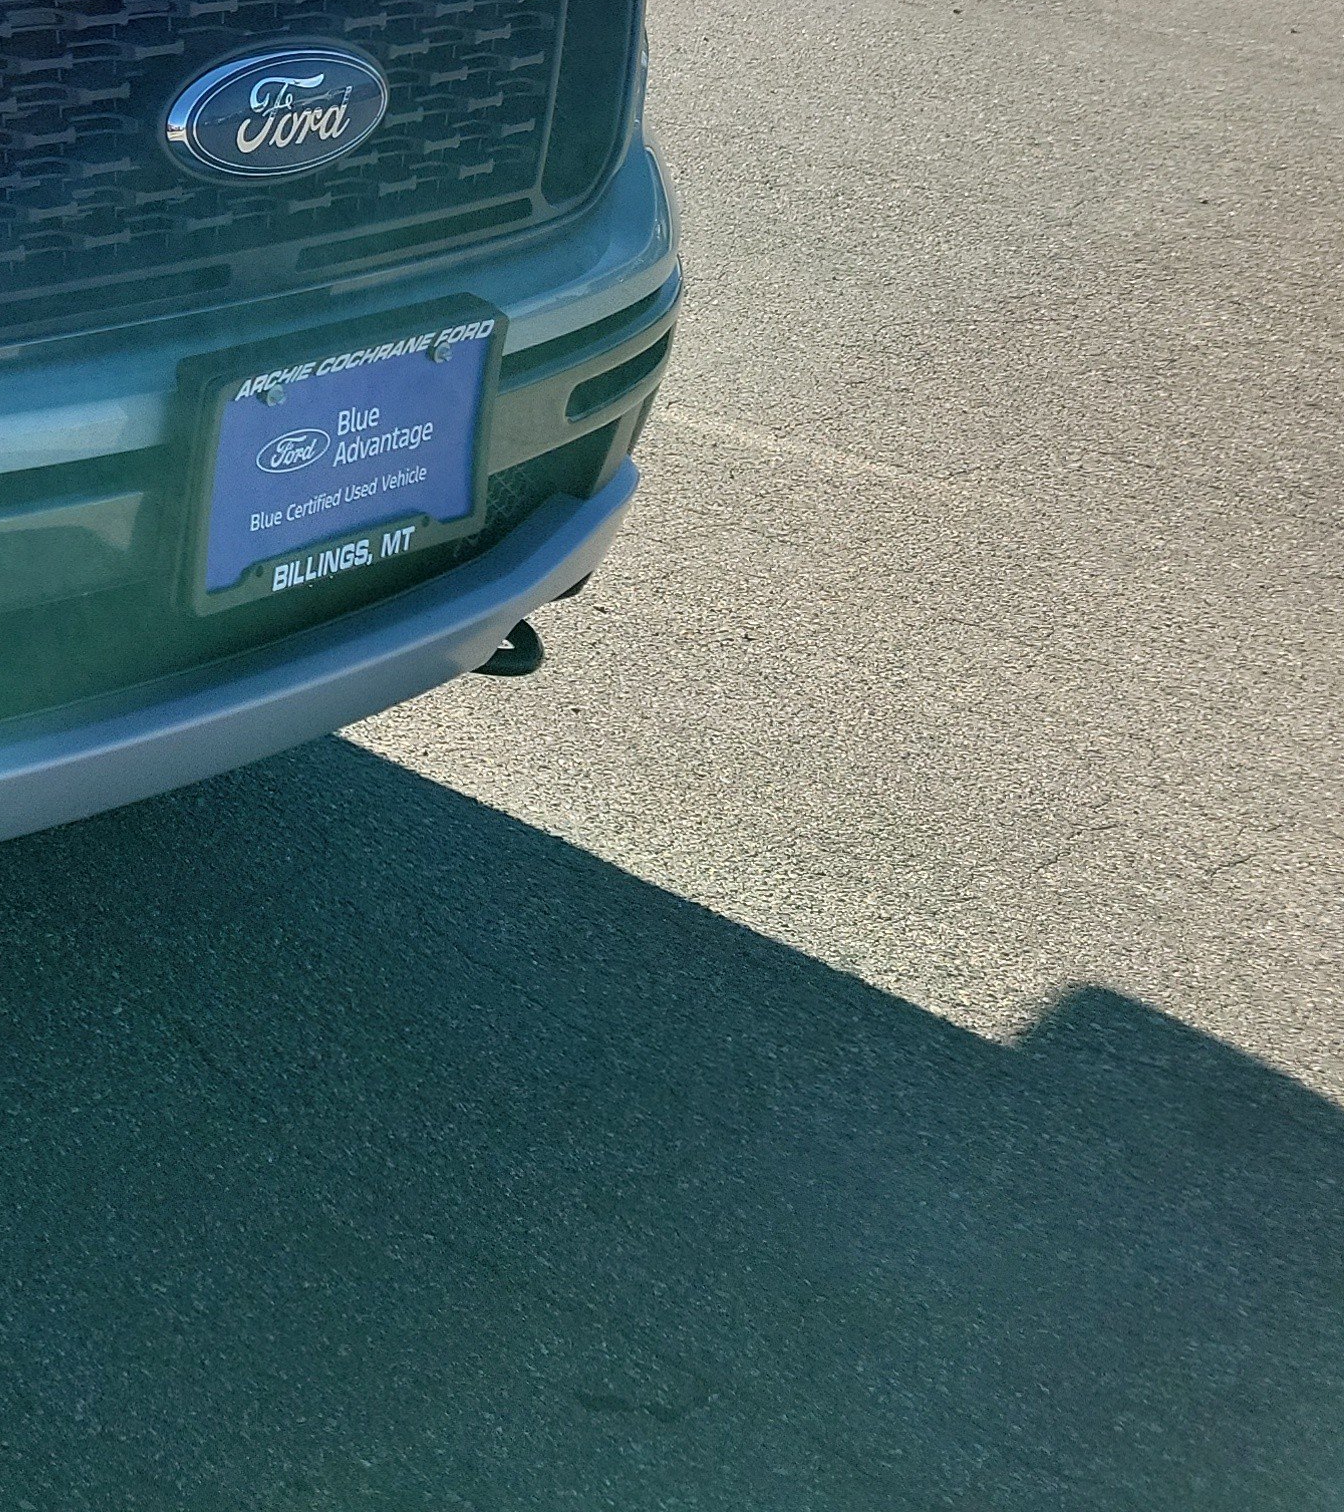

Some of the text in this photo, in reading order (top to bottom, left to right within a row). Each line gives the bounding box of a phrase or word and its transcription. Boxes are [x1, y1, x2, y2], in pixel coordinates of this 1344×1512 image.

[236, 73, 352, 156] Ford
[235, 318, 495, 402] ARCHIE COCHRANE FORD
[269, 435, 318, 468] Ford
[332, 419, 434, 468] Advantage
[337, 404, 380, 436] Blue
[250, 464, 428, 532] Blue Certified Used Vehicle
[272, 525, 416, 592] BILLINGS, MT
